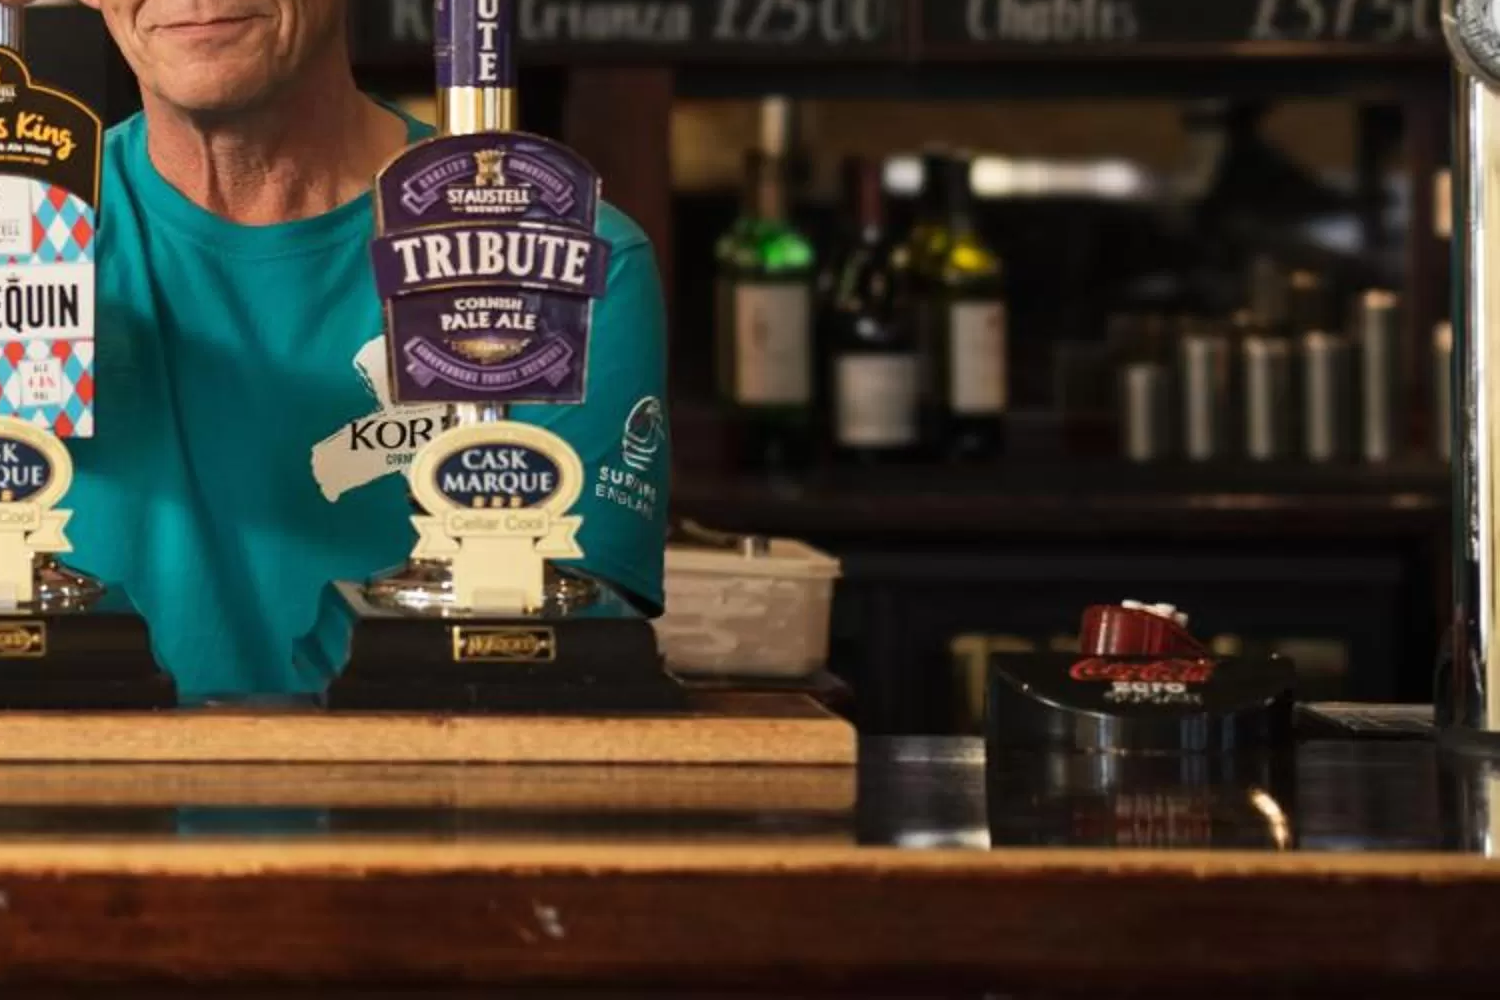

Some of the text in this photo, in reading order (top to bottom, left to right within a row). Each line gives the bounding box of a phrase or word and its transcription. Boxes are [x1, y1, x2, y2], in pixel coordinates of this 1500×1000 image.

[15, 110, 77, 161] King
[392, 230, 591, 285] TRIBUTE
[453, 296, 523, 311] CORNISH
[440, 312, 537, 331] PALE ALE
[461, 449, 529, 470] CASK
[443, 472, 553, 493] MARQUE
[0, 508, 36, 524] Cool
[451, 515, 545, 531] Cellar Cool
